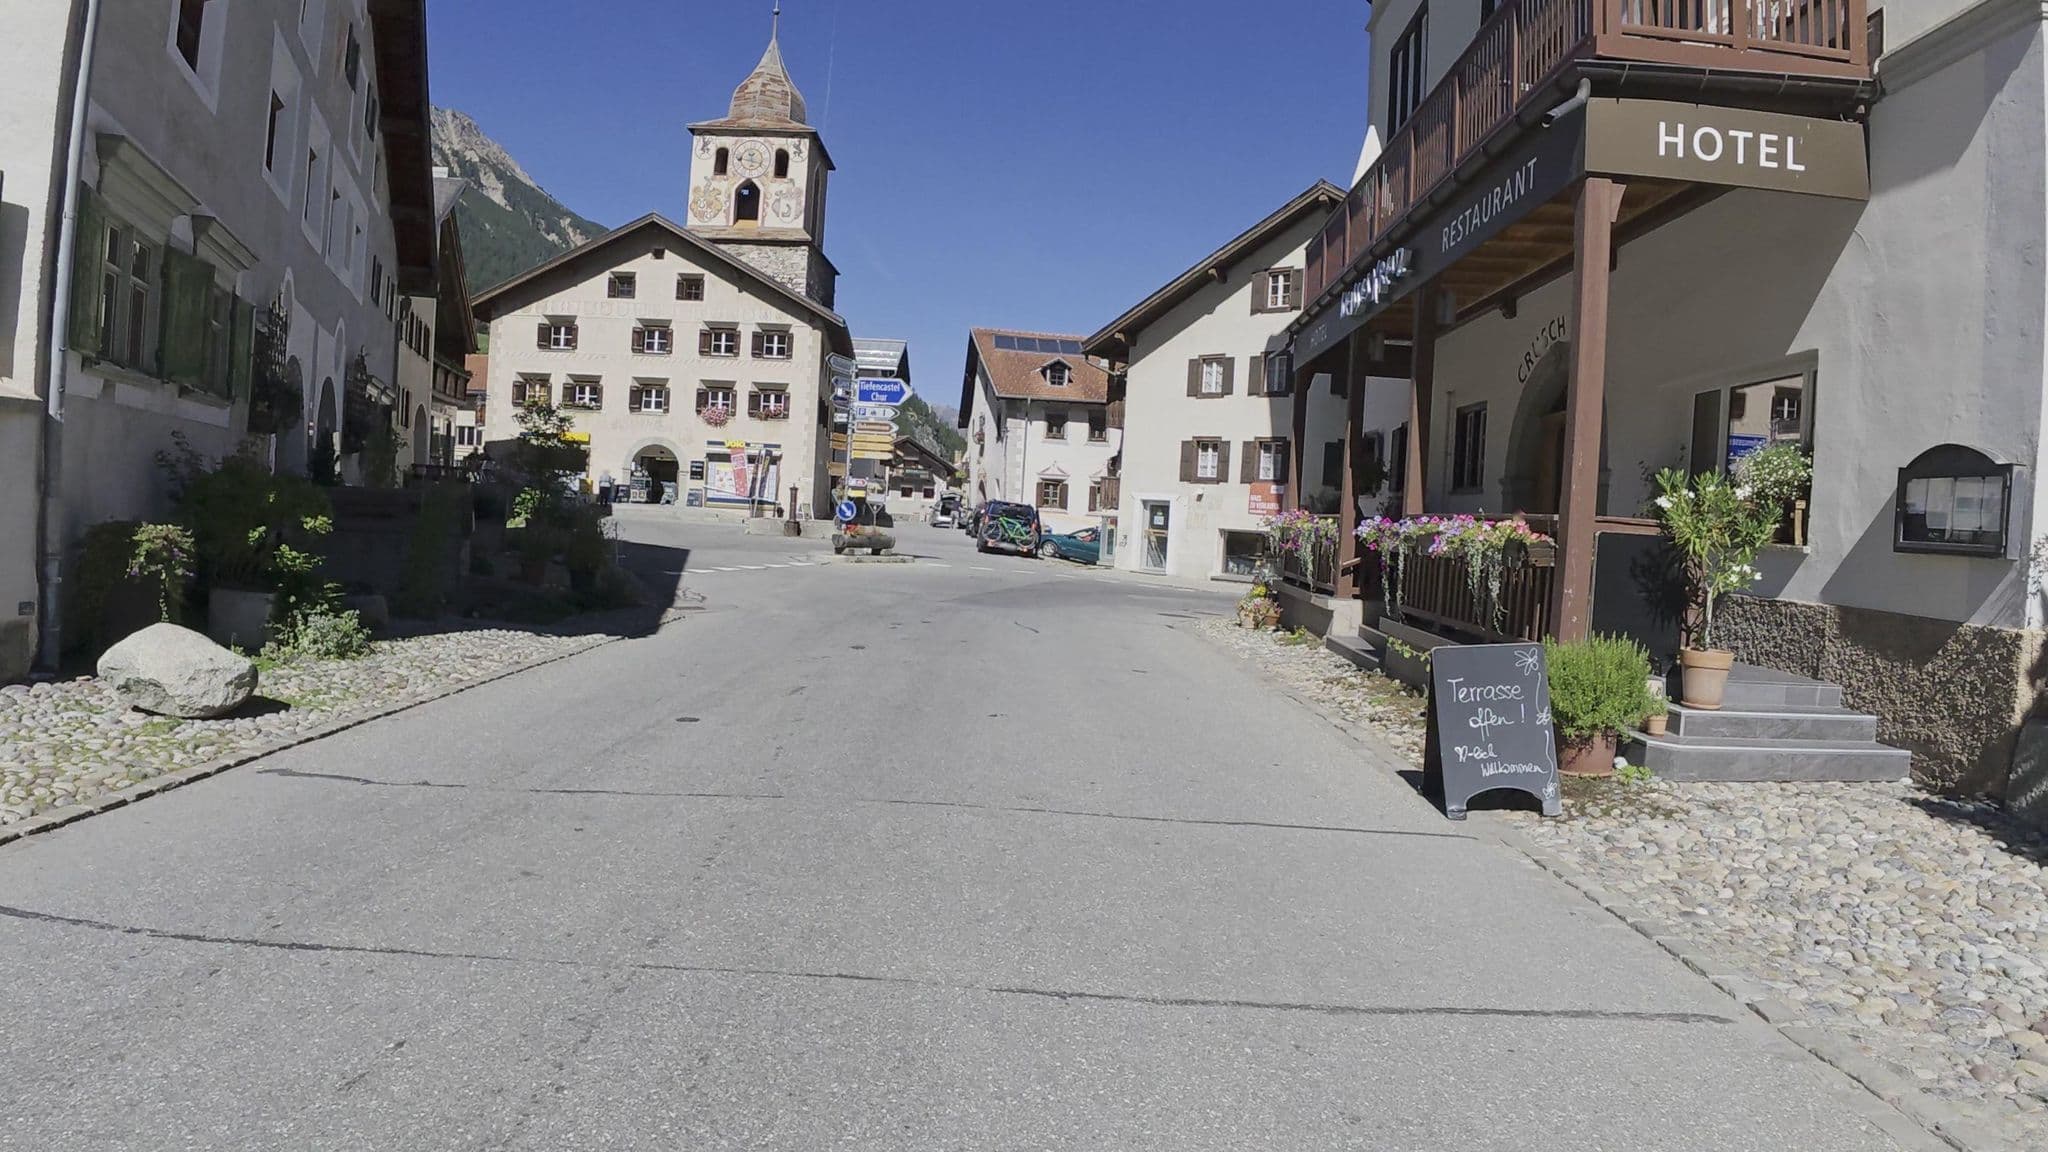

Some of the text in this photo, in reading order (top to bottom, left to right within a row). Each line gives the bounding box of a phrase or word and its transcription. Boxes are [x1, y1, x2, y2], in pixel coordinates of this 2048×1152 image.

[1658, 121, 1805, 171] HOTEL
[1442, 157, 1537, 253] RESTAURANT
[860, 381, 900, 392] Tiefencastel
[871, 392, 888, 401] Chur
[1447, 678, 1524, 703] Terrasse
[1481, 761, 1549, 776] Willkommen
